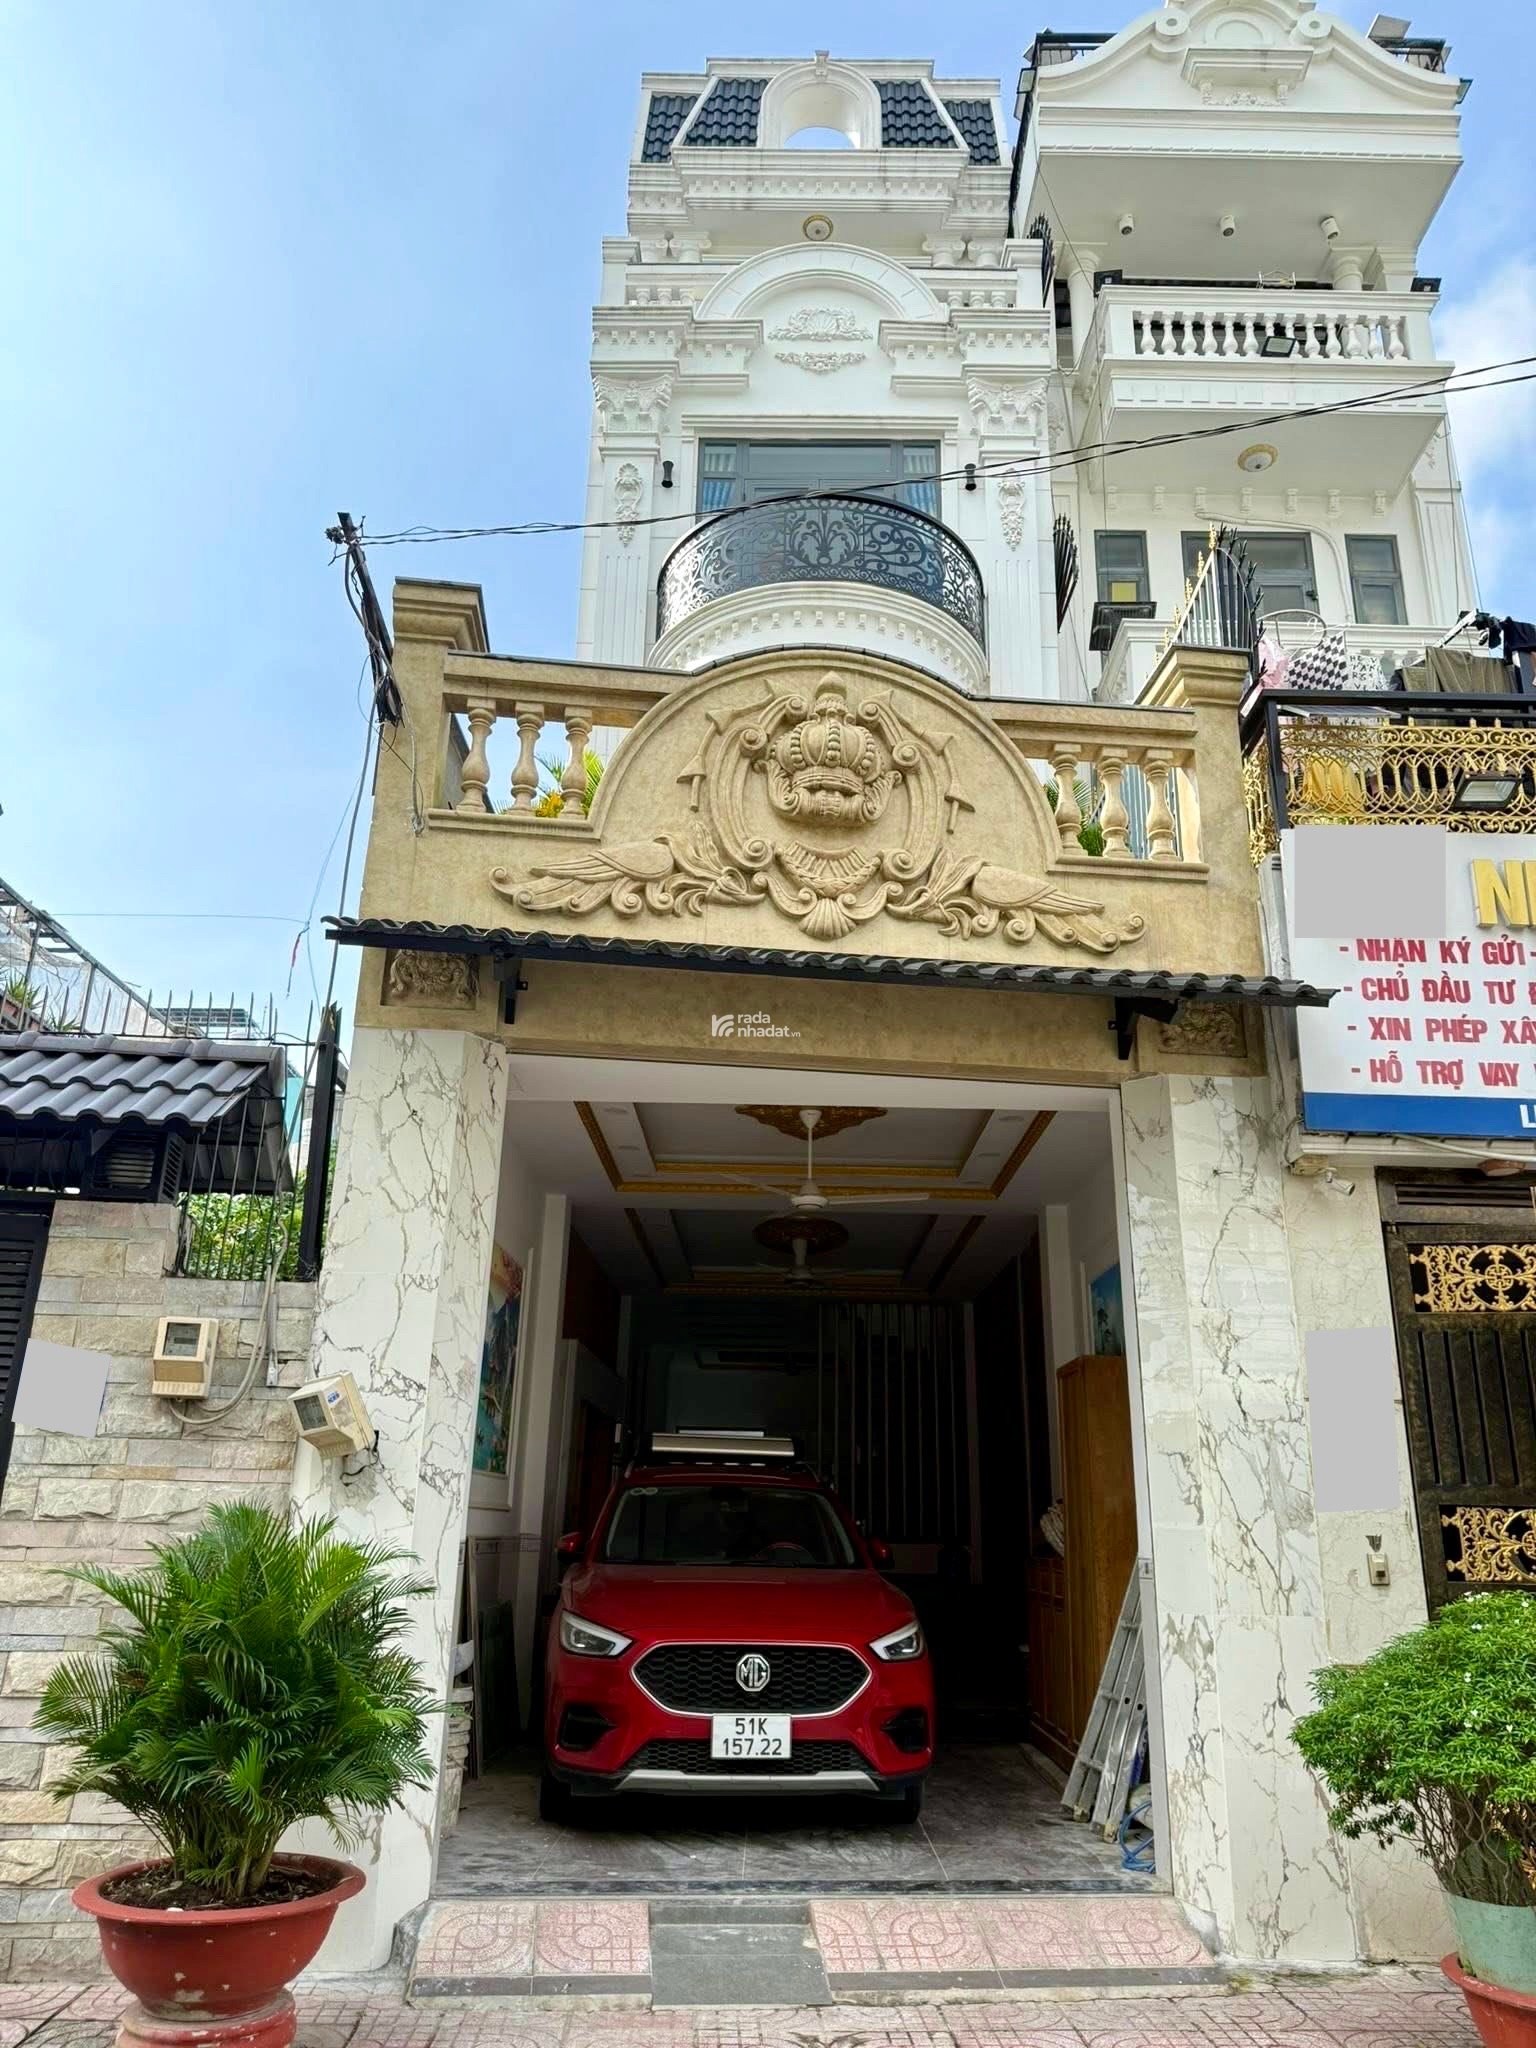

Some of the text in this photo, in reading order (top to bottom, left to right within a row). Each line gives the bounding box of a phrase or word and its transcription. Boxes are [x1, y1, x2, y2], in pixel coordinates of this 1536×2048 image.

[1439, 936, 1471, 964] KÝ
[1482, 933, 1526, 965] GỬI
[1361, 970, 1410, 1001] CHỦ
[1422, 970, 1471, 1004] ĐẦU
[1483, 979, 1516, 1004] TƯ
[1368, 1016, 1412, 1041] XIN
[1425, 1013, 1488, 1043] PHÉP
[1369, 1050, 1403, 1083] HỖ
[1416, 1058, 1464, 1090] TRỢ
[1478, 1062, 1520, 1087] VAY
[739, 1656, 768, 1689] MG
[735, 1717, 768, 1735] 51K
[723, 1738, 782, 1756] 157.22
